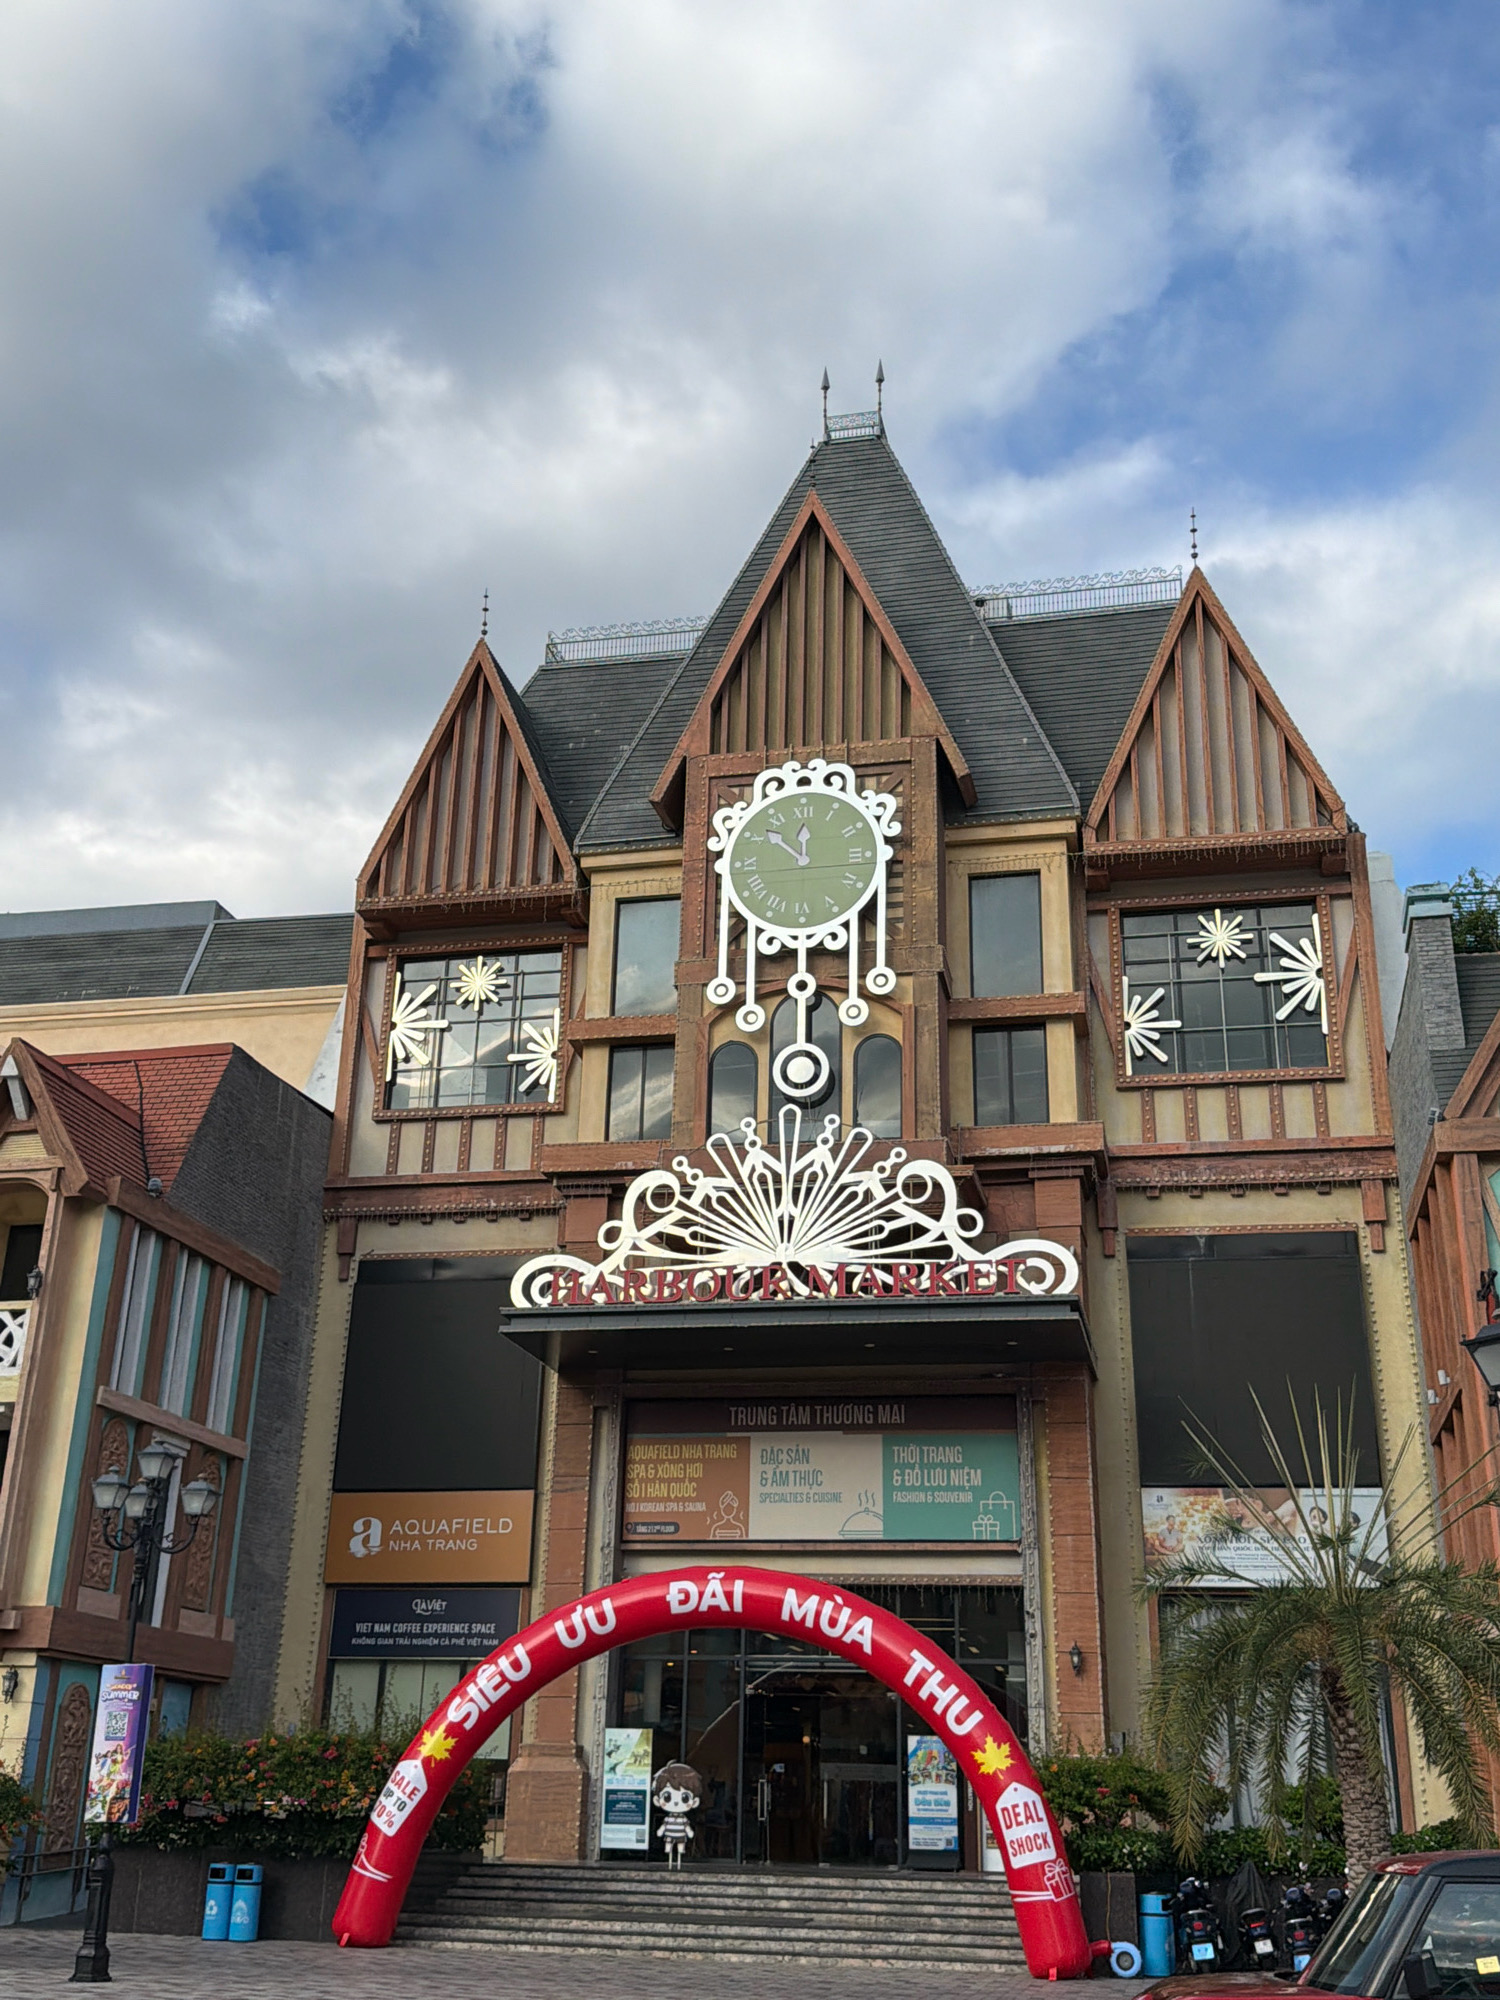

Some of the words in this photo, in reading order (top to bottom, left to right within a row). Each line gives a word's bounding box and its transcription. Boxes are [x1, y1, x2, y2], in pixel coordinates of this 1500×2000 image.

[769, 813, 785, 828] XI
[793, 806, 814, 818] XII
[825, 810, 834, 821] I
[751, 833, 764, 844] X
[842, 826, 856, 838] II
[744, 856, 756, 871] IX
[849, 848, 861, 863] III
[747, 874, 767, 900] VIII
[842, 872, 857, 889] IV
[767, 895, 787, 912] VII
[795, 901, 810, 914] VI
[824, 896, 834, 907] V
[550, 1265, 794, 1305] HARBOUR
[805, 1259, 1028, 1299] MARKET
[729, 1406, 777, 1426] TRUNG
[781, 1403, 811, 1425] TÂM
[815, 1403, 873, 1425] THƯƠNG
[628, 1445, 680, 1461] AQUAFIELD
[681, 1445, 702, 1459] NHA
[704, 1444, 737, 1459] TRANG
[760, 1446, 784, 1468] ĐẶC
[786, 1444, 810, 1465] SẢN
[892, 1443, 920, 1464] THỜI
[921, 1446, 963, 1463] TRANG
[627, 1464, 646, 1479] SPA
[647, 1464, 655, 1478] &
[657, 1462, 684, 1478] XÔNG
[686, 1462, 704, 1478] HƠI
[760, 1470, 769, 1487] &
[792, 1468, 824, 1490] THỰC
[893, 1469, 902, 1487] &
[924, 1468, 947, 1487] LƯU
[950, 1466, 982, 1490] NIỆM
[647, 1480, 668, 1498] HÀN
[893, 1491, 926, 1503] FASHION
[927, 1491, 933, 1503] &
[934, 1491, 973, 1503] SOUVENIR
[760, 1492, 804, 1504] SPECIALTIES
[805, 1492, 811, 1503] &
[812, 1492, 843, 1503] CUISINE
[640, 1502, 665, 1512] KOREAN
[666, 1502, 678, 1512] SPA
[685, 1502, 707, 1512] SAUNA
[389, 1518, 513, 1536] AQUAFIELD
[389, 1540, 421, 1551] NHA
[427, 1539, 478, 1551] TRANG
[355, 1622, 373, 1633] VIET
[374, 1622, 391, 1633] NAM
[392, 1622, 421, 1633] COFFEE
[423, 1623, 469, 1634] EXPERIENCE
[471, 1623, 496, 1634] SPACE
[482, 1638, 499, 1646] NAM
[446, 1643, 532, 1731] SIÊU
[554, 1597, 617, 1649] ƯU
[666, 1571, 744, 1614] ĐÃI
[780, 1587, 874, 1656] MÙA
[902, 1648, 985, 1736] THU
[101, 1690, 140, 1702] SUMMER
[390, 1770, 421, 1802] SALE
[382, 1786, 394, 1800] UP
[392, 1795, 407, 1812] TO
[1000, 1800, 1044, 1830] DEAL
[1009, 1832, 1051, 1857] SHOCK
